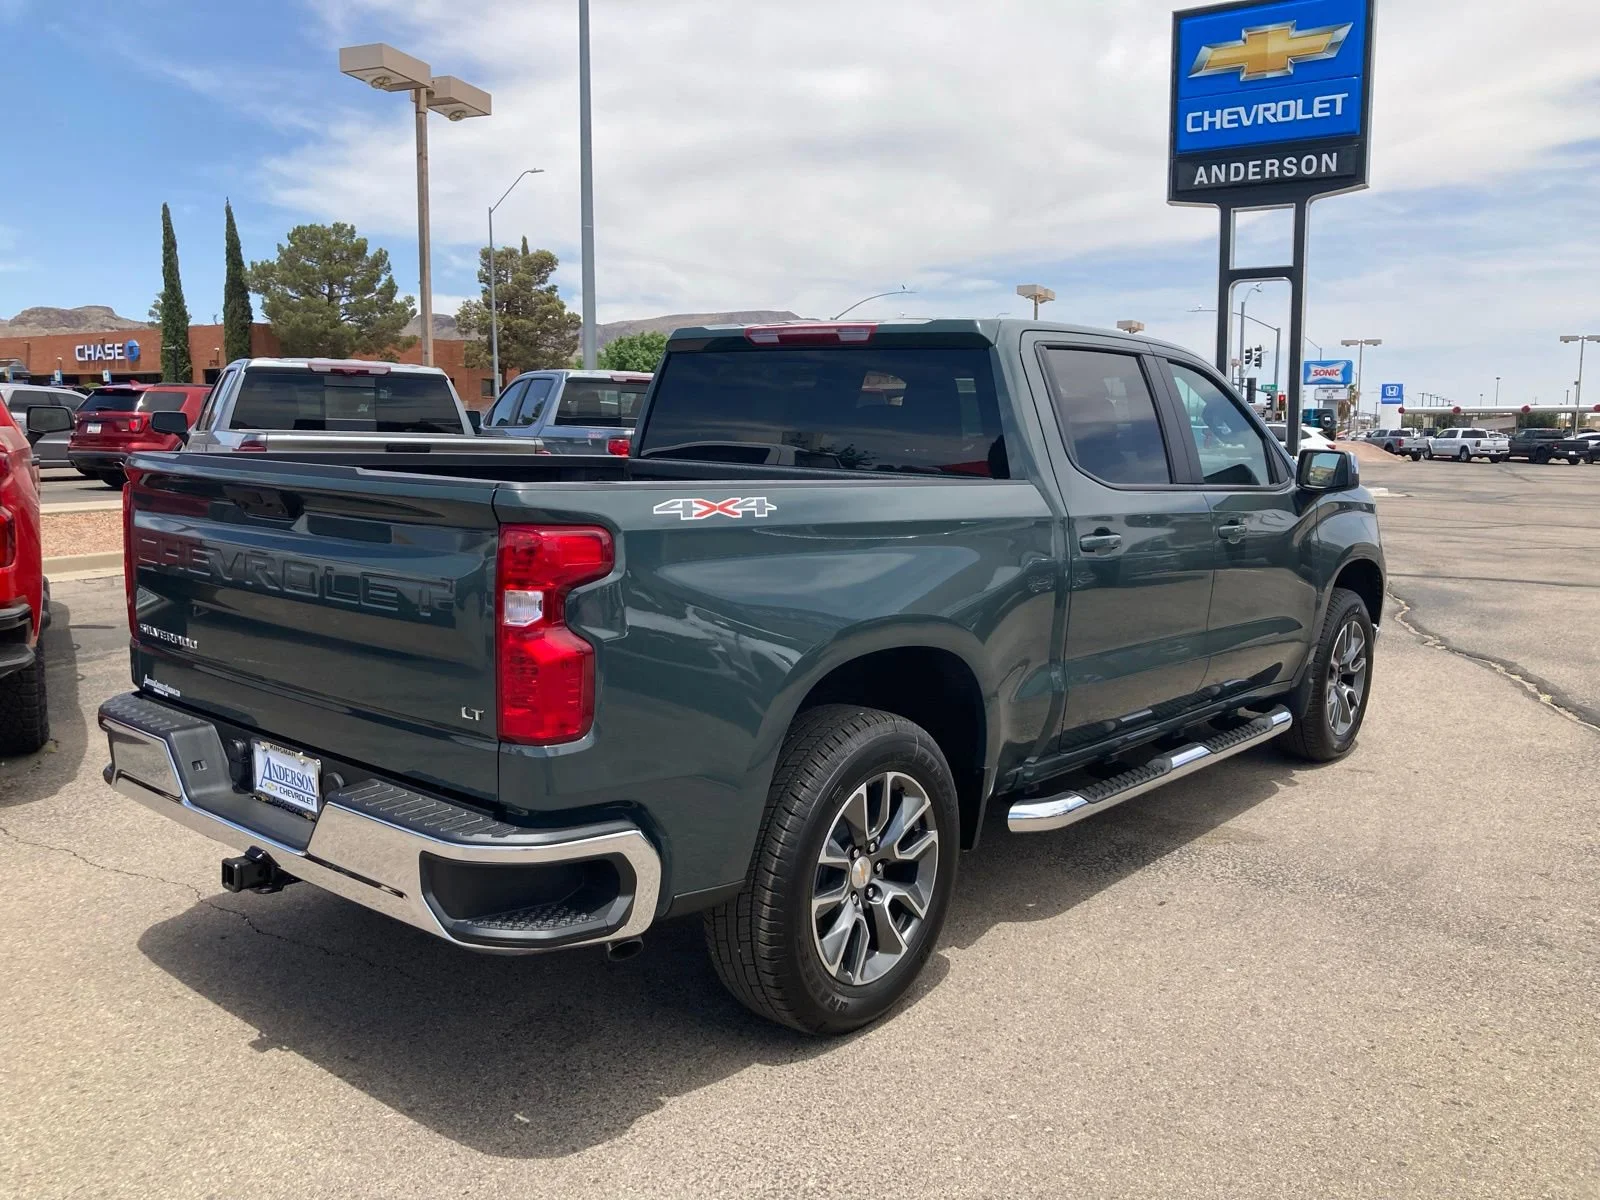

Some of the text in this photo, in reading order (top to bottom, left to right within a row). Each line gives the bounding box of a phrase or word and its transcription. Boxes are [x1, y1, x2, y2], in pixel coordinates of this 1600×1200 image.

[1186, 92, 1349, 133] CHEVROLET
[1193, 152, 1338, 185] ANDERSON
[75, 343, 126, 361] CHASE
[1312, 368, 1340, 377] SONIC
[137, 536, 456, 618] CHEVROLET
[461, 706, 484, 721] LT
[259, 757, 316, 793] ANDERSON
[279, 786, 315, 806] CHEVROLET
